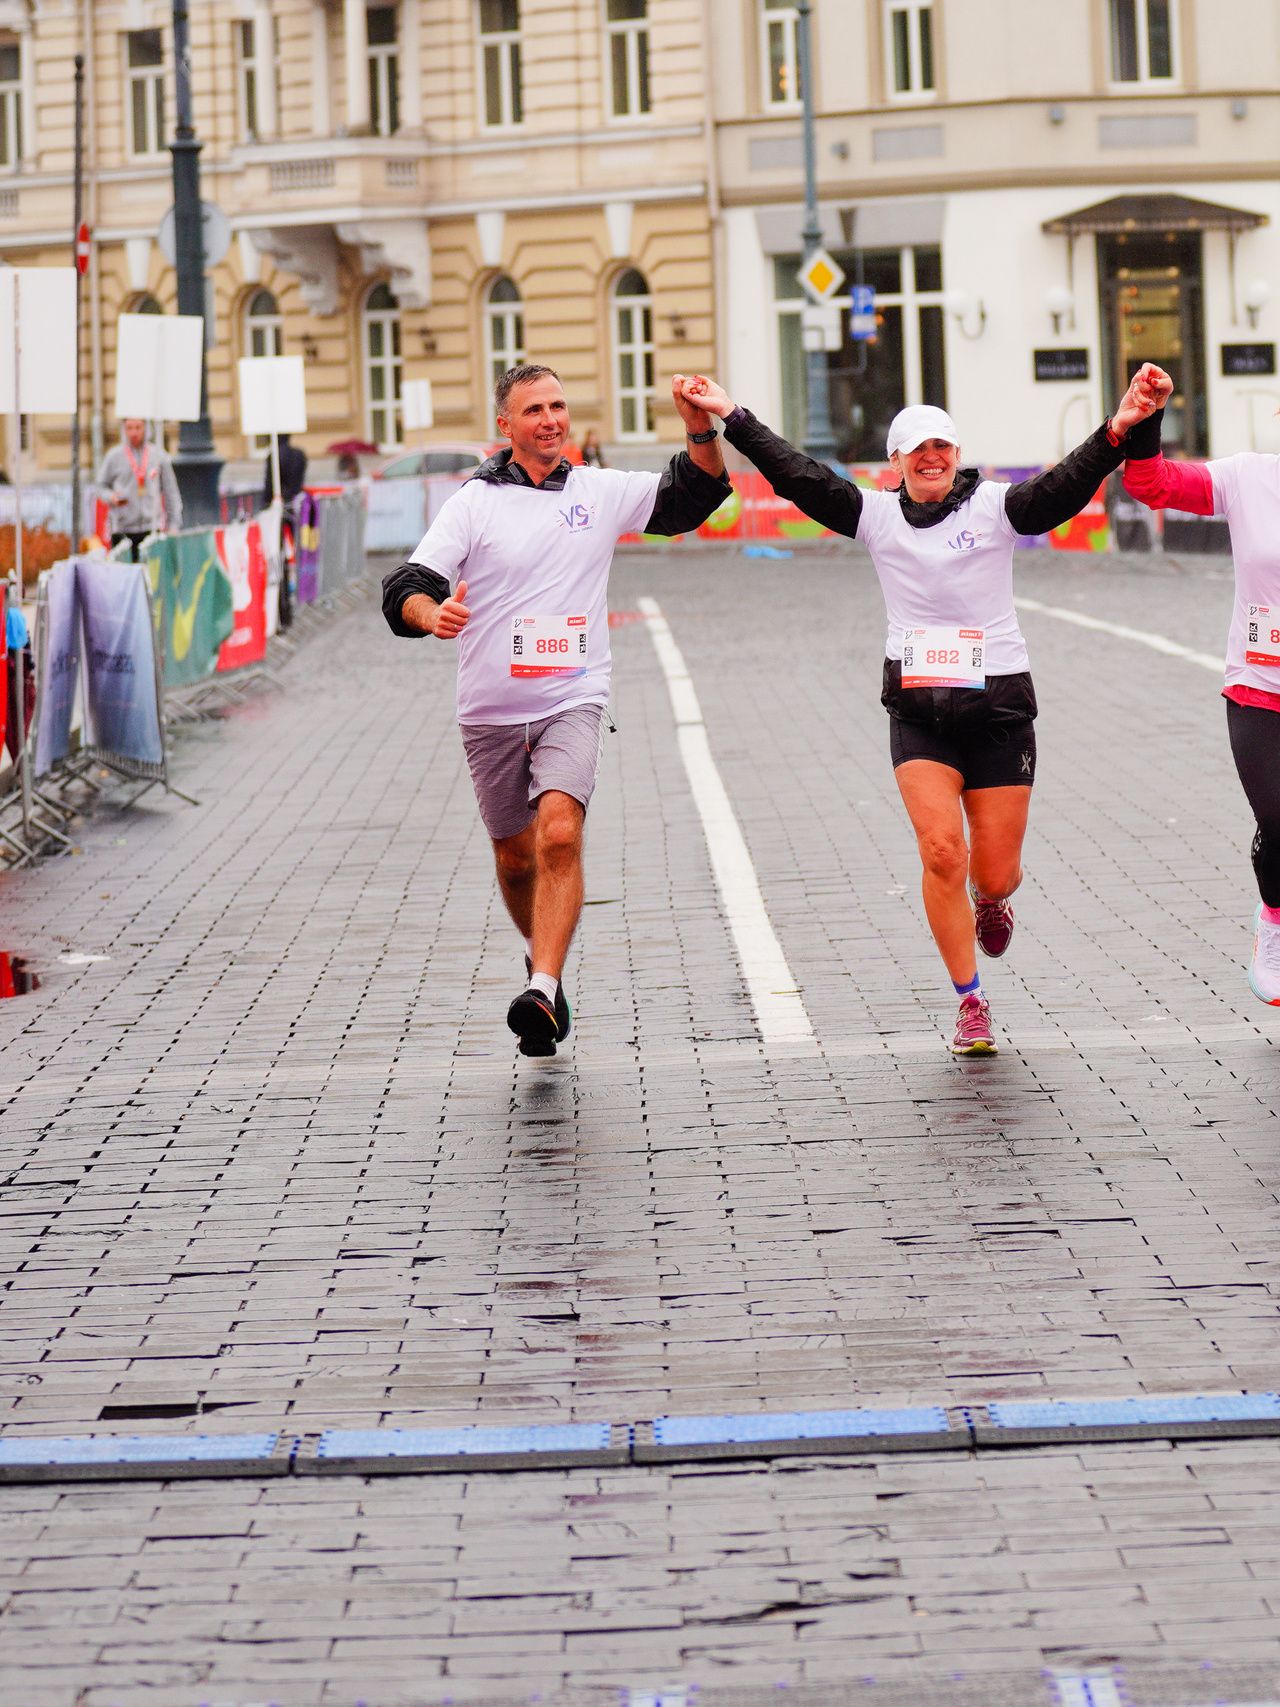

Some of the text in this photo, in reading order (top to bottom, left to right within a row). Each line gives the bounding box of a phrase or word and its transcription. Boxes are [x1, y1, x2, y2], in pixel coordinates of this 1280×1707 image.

[559, 504, 589, 528] VS
[536, 639, 569, 653] 886
[926, 650, 959, 664] 882
